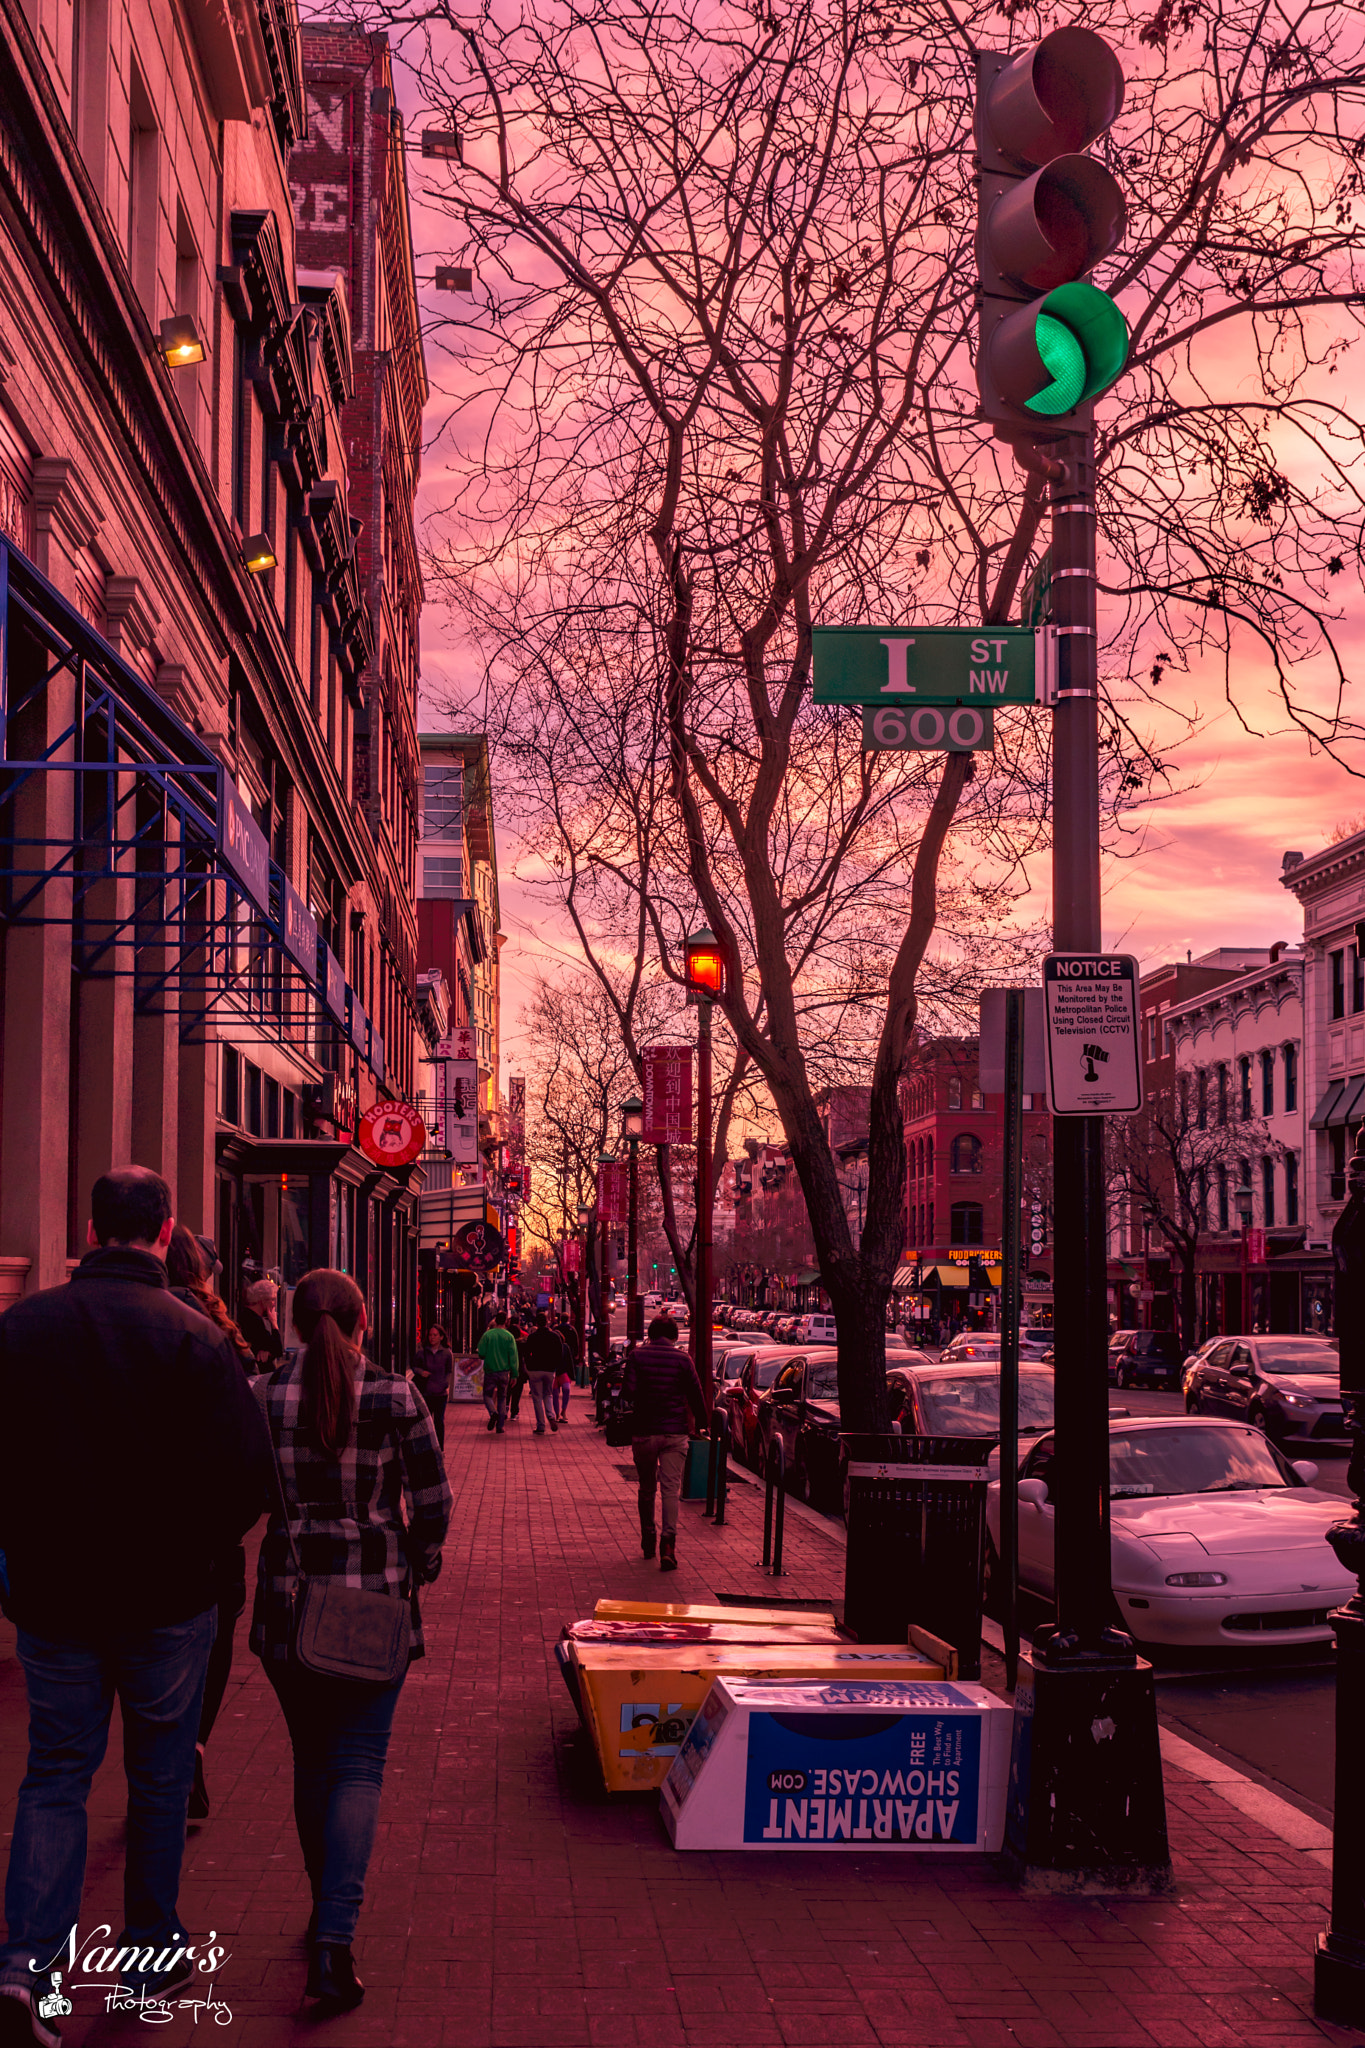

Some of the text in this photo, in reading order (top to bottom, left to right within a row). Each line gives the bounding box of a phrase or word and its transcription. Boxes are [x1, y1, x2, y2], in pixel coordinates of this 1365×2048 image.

[879, 638, 1009, 693] I ST
[969, 670, 1009, 694] NW
[872, 707, 984, 746] 600
[235, 812, 250, 868] PNC
[1056, 961, 1122, 977] NOTICE
[1057, 983, 1123, 993] This Area May Be
[1057, 994, 1123, 1003] Monitored by the
[1053, 1014, 1131, 1025] Using Closed Circuit
[1054, 1004, 1128, 1014] Metropolitan Police
[1055, 1025, 1130, 1035] Television (CCTV)
[665, 1046, 681, 1144] 欢迎到中国城
[364, 1101, 422, 1127] HOOTERS
[910, 1731, 926, 1766] FREE
[932, 1720, 944, 1766] The Best Way
[943, 1733, 952, 1766] to Find an
[952, 1729, 963, 1766] Apartment
[770, 1774, 805, 1790] COM
[762, 1798, 960, 1840] APARTMENT
